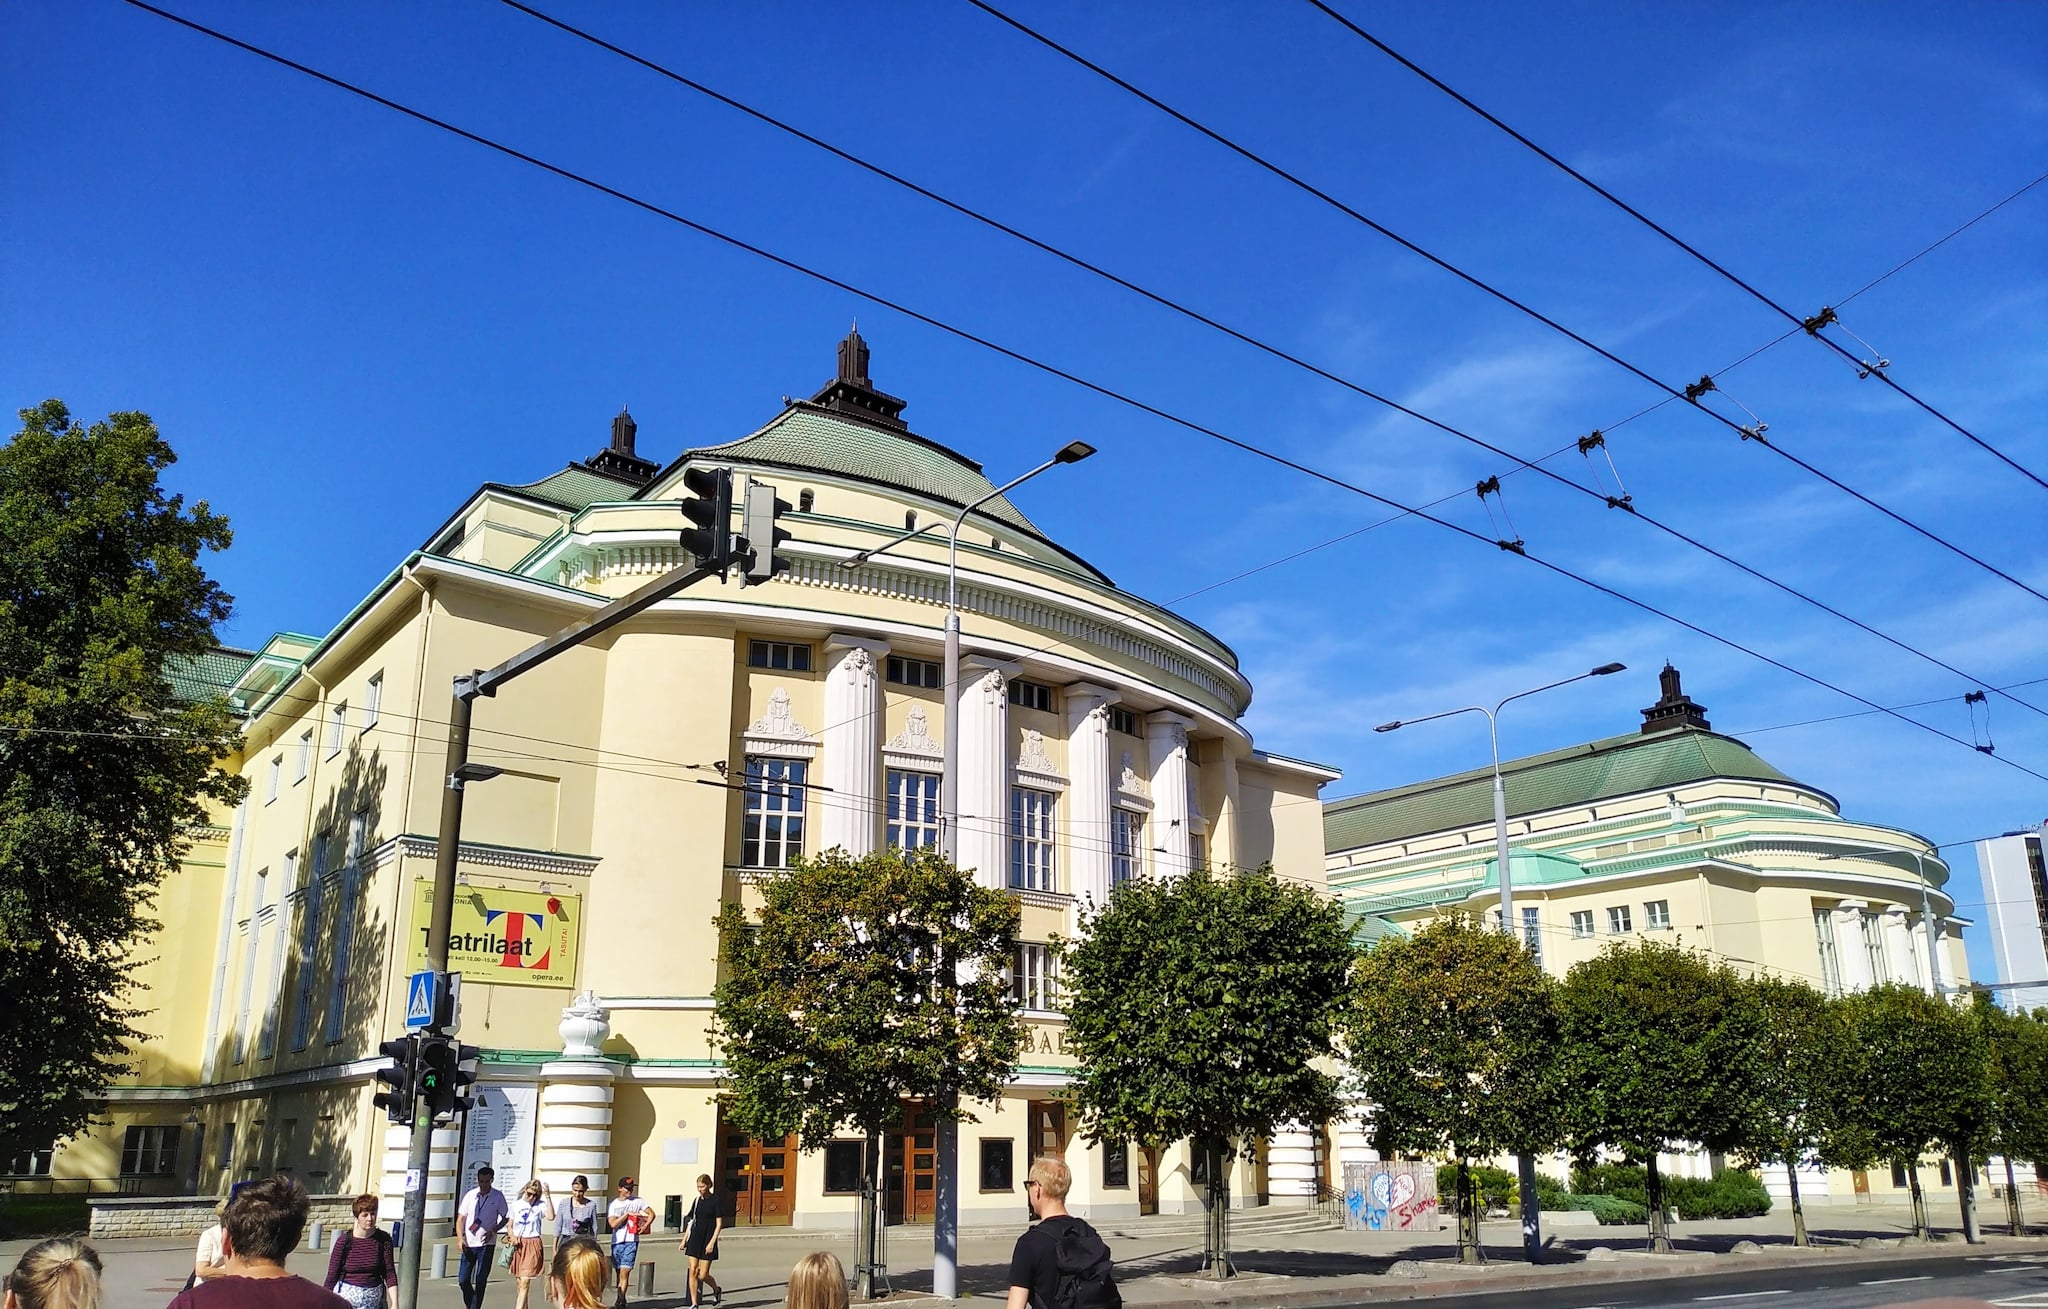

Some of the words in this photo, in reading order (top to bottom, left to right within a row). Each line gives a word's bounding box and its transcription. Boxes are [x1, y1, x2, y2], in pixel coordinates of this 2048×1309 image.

[421, 927, 533, 956] Tatrilaat
[560, 928, 568, 958] TASUTA!
[532, 974, 564, 982] opera.ee
[1020, 1029, 1074, 1056] BAL
